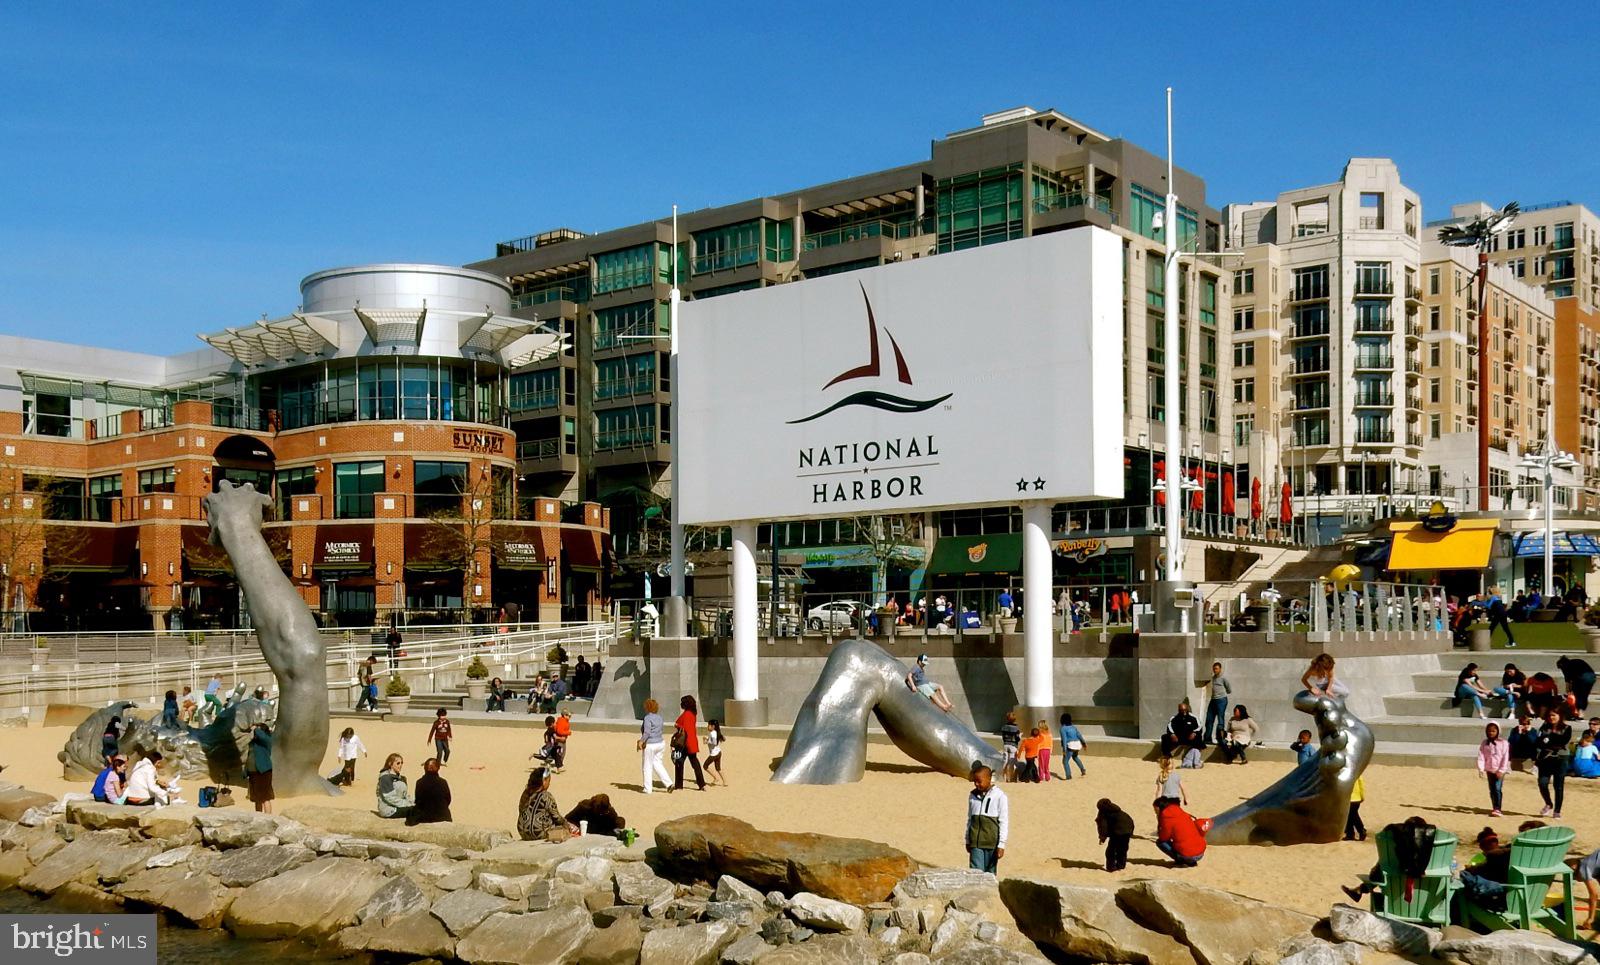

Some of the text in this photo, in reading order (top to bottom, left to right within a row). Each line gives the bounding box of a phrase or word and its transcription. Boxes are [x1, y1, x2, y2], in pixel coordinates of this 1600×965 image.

[453, 432, 504, 451] SUNSET
[470, 445, 494, 455] ROOM
[799, 435, 939, 468] NATIONAL
[812, 475, 924, 503] HARBOR
